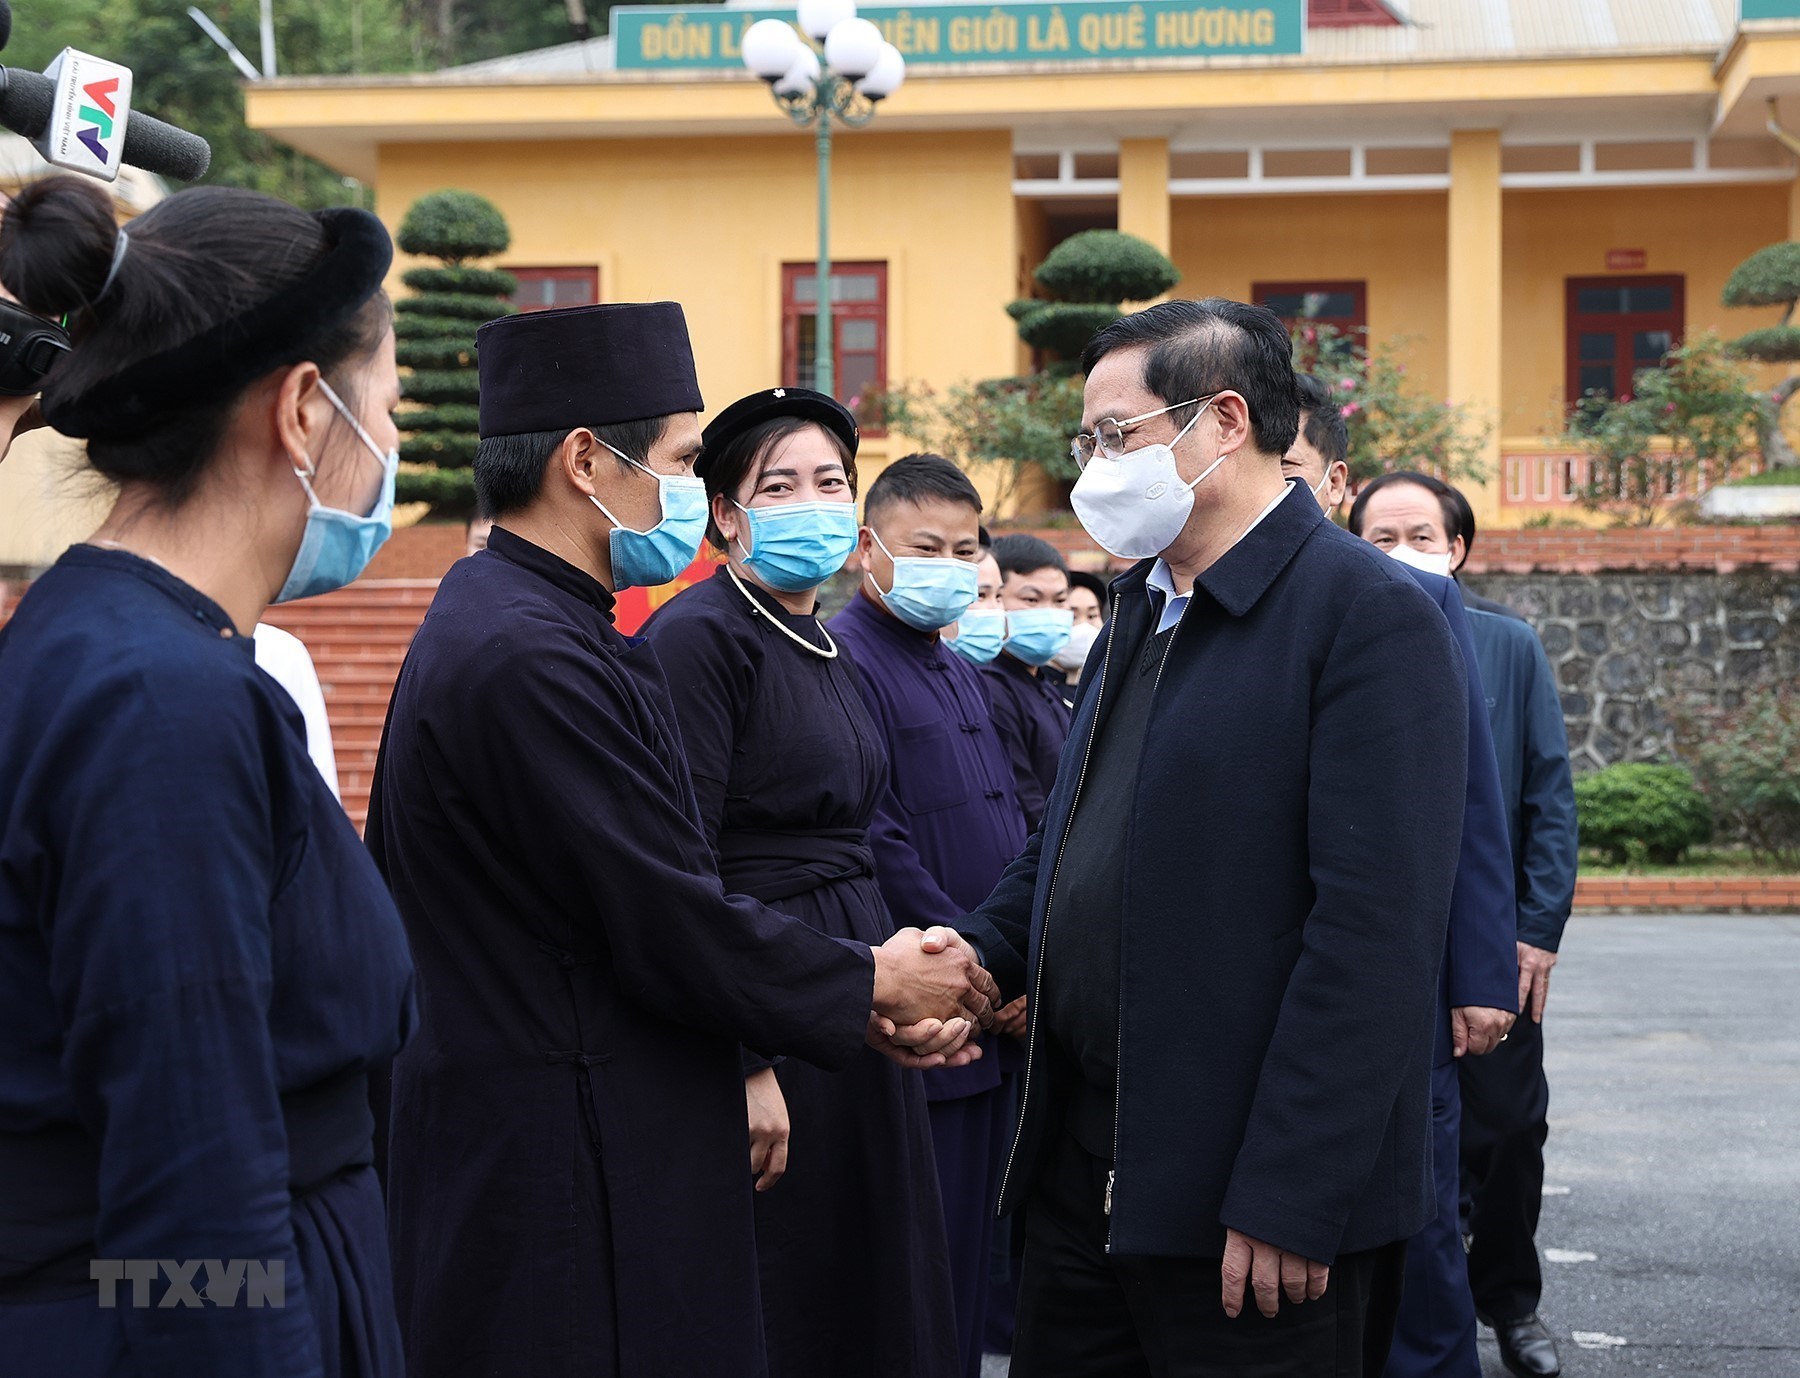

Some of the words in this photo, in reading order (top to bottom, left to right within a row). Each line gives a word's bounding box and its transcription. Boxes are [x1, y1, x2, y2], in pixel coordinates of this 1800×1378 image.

[867, 9, 940, 55] IÊN
[948, 8, 1019, 53] GIỚI
[1026, 7, 1070, 52] LÀ
[1079, 4, 1147, 53] QUÊ
[1154, 7, 1276, 49] HƯƠNG
[60, 137, 68, 155] NAM
[76, 77, 119, 165] VTV
